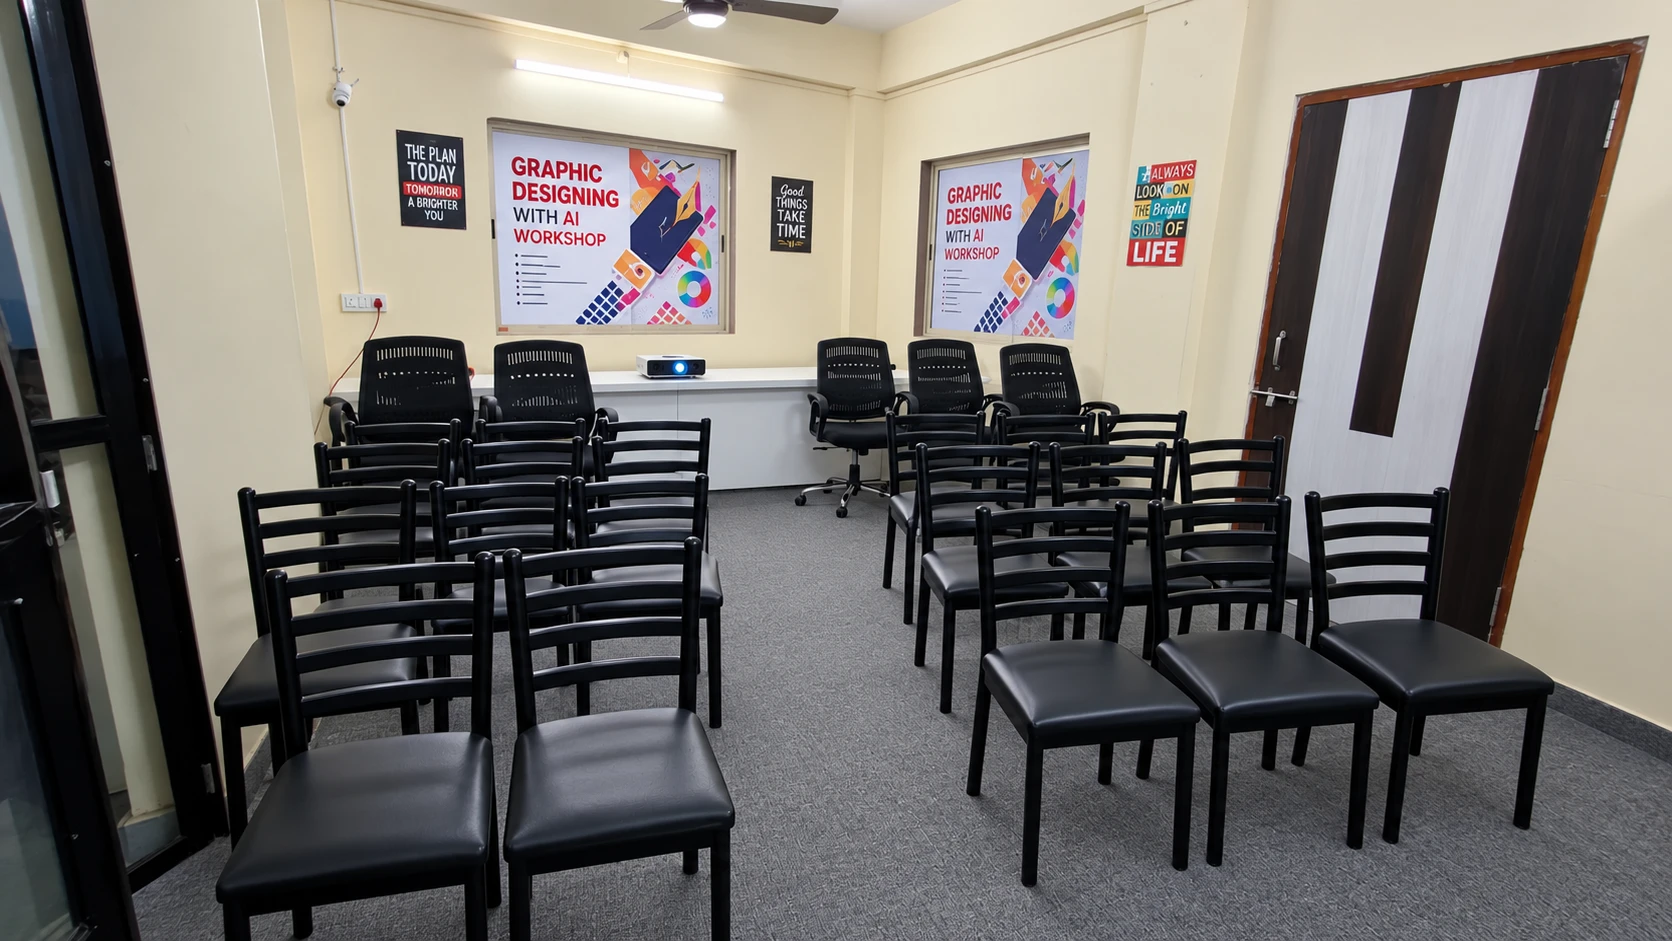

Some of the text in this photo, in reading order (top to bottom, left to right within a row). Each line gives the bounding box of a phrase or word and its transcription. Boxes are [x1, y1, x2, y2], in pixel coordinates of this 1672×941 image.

[404, 144, 456, 164] THE PLAN
[407, 162, 456, 184] TODAY
[511, 156, 602, 183] GRAPHIC
[1152, 164, 1194, 180] ALWAYS
[512, 182, 620, 208] DESIGNING
[780, 184, 804, 198] Good
[948, 182, 1002, 204] GRAPHIC
[1136, 183, 1190, 199] LOOK ON
[408, 196, 458, 210] A BRIGHTER
[776, 196, 808, 210] THINGS
[1134, 200, 1186, 220] THE Bright
[424, 210, 444, 221] YOU
[513, 206, 580, 226] WITH AI
[777, 210, 806, 222] TAKE
[946, 204, 1012, 225] DESIGNING
[514, 228, 606, 246] WORKSHOP
[776, 224, 806, 238] TIME
[946, 228, 984, 243] WITH AI
[1165, 222, 1184, 236] OF
[944, 246, 1000, 260] WORKSHOP
[1133, 241, 1178, 262] LIFE
